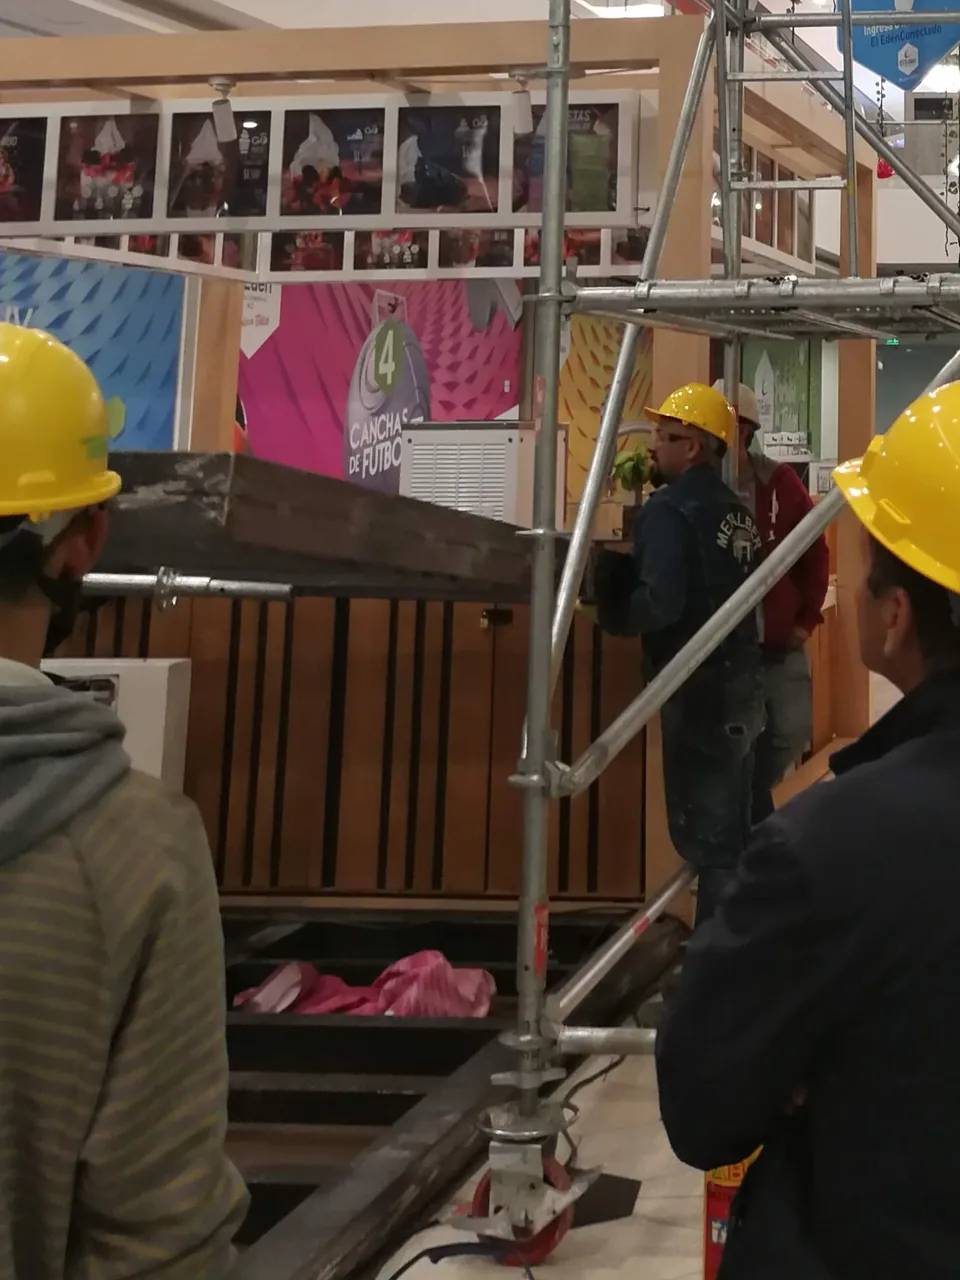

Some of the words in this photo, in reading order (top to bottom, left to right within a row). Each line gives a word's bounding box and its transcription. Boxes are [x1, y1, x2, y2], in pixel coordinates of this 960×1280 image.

[378, 329, 396, 386] 4
[349, 453, 360, 475] DE
[361, 436, 403, 480] FUTBO
